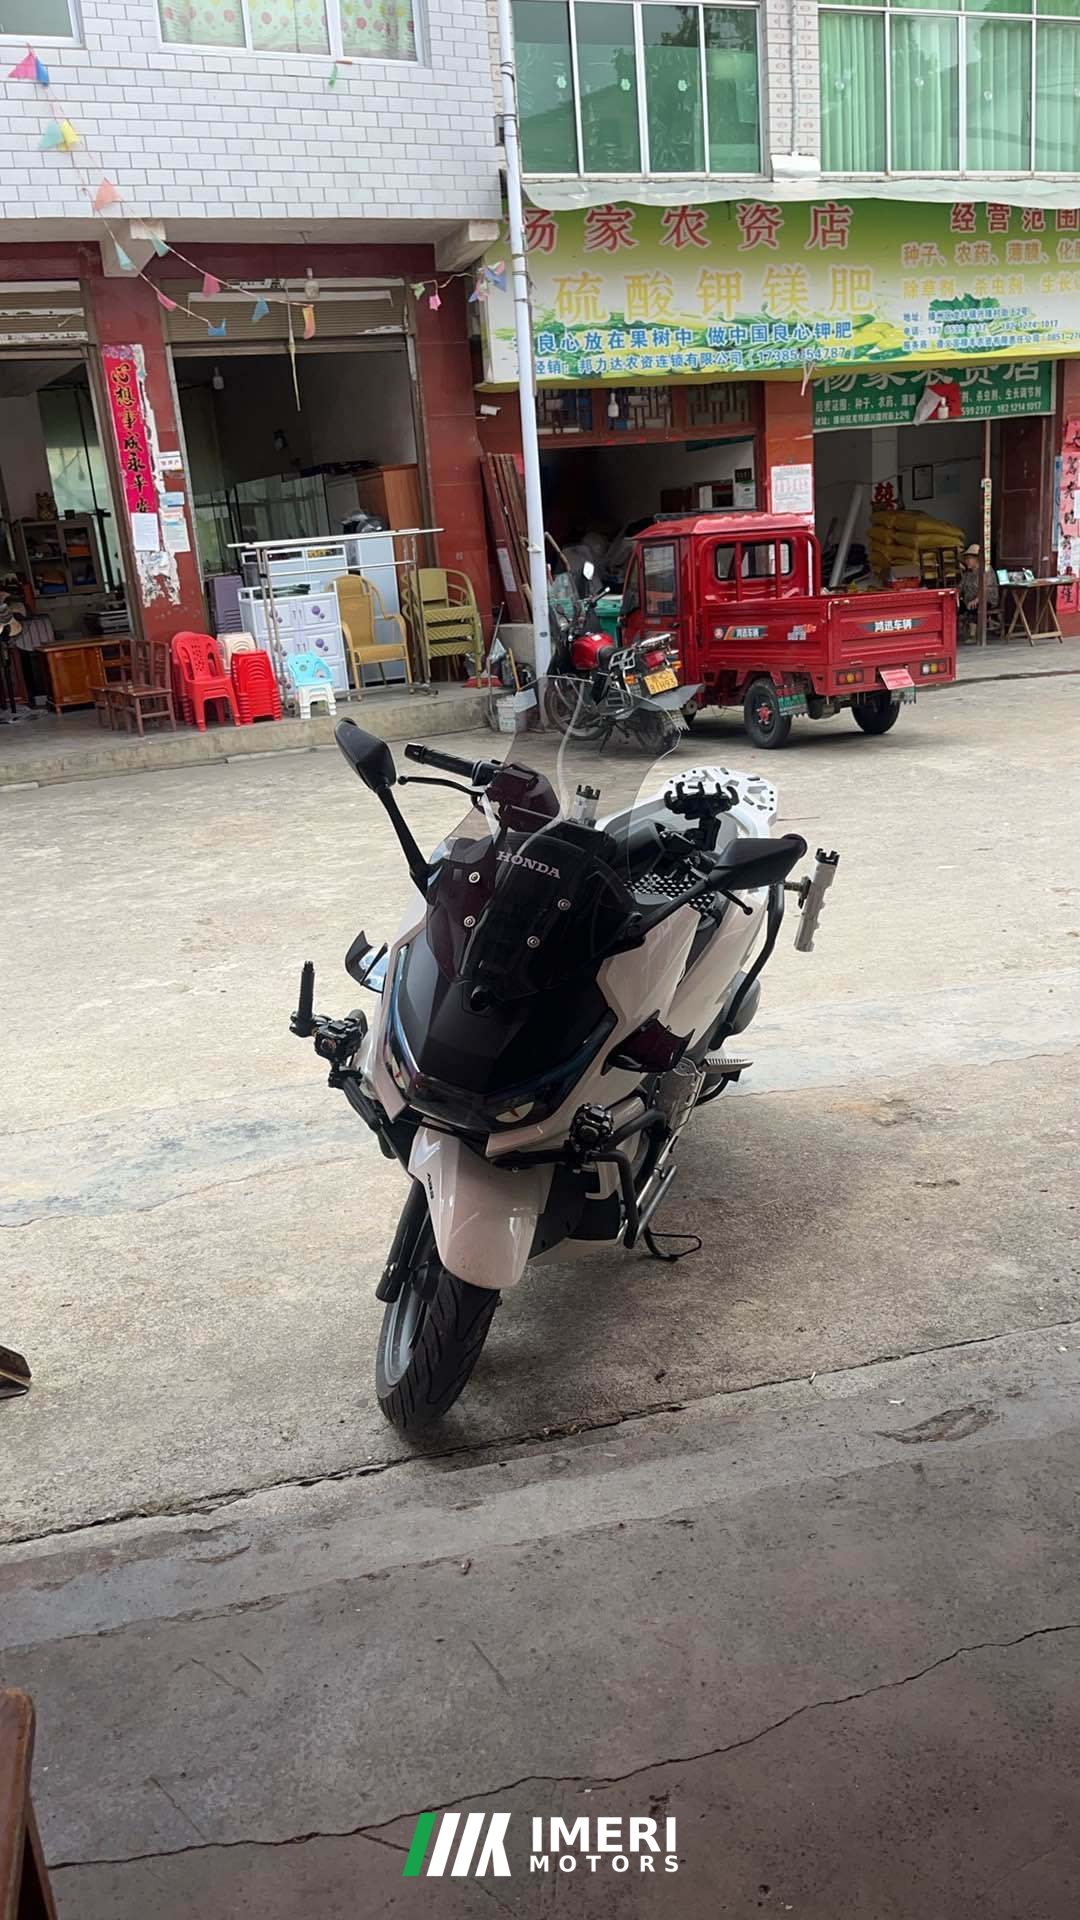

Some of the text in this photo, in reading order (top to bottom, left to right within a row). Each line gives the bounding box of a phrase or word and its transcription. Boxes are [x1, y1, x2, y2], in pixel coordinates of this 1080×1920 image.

[553, 265, 875, 322] 硫酸钾镁肥
[513, 321, 853, 352] 良心放在果树中 做中国良心钾肥
[496, 850, 561, 879] HONDA
